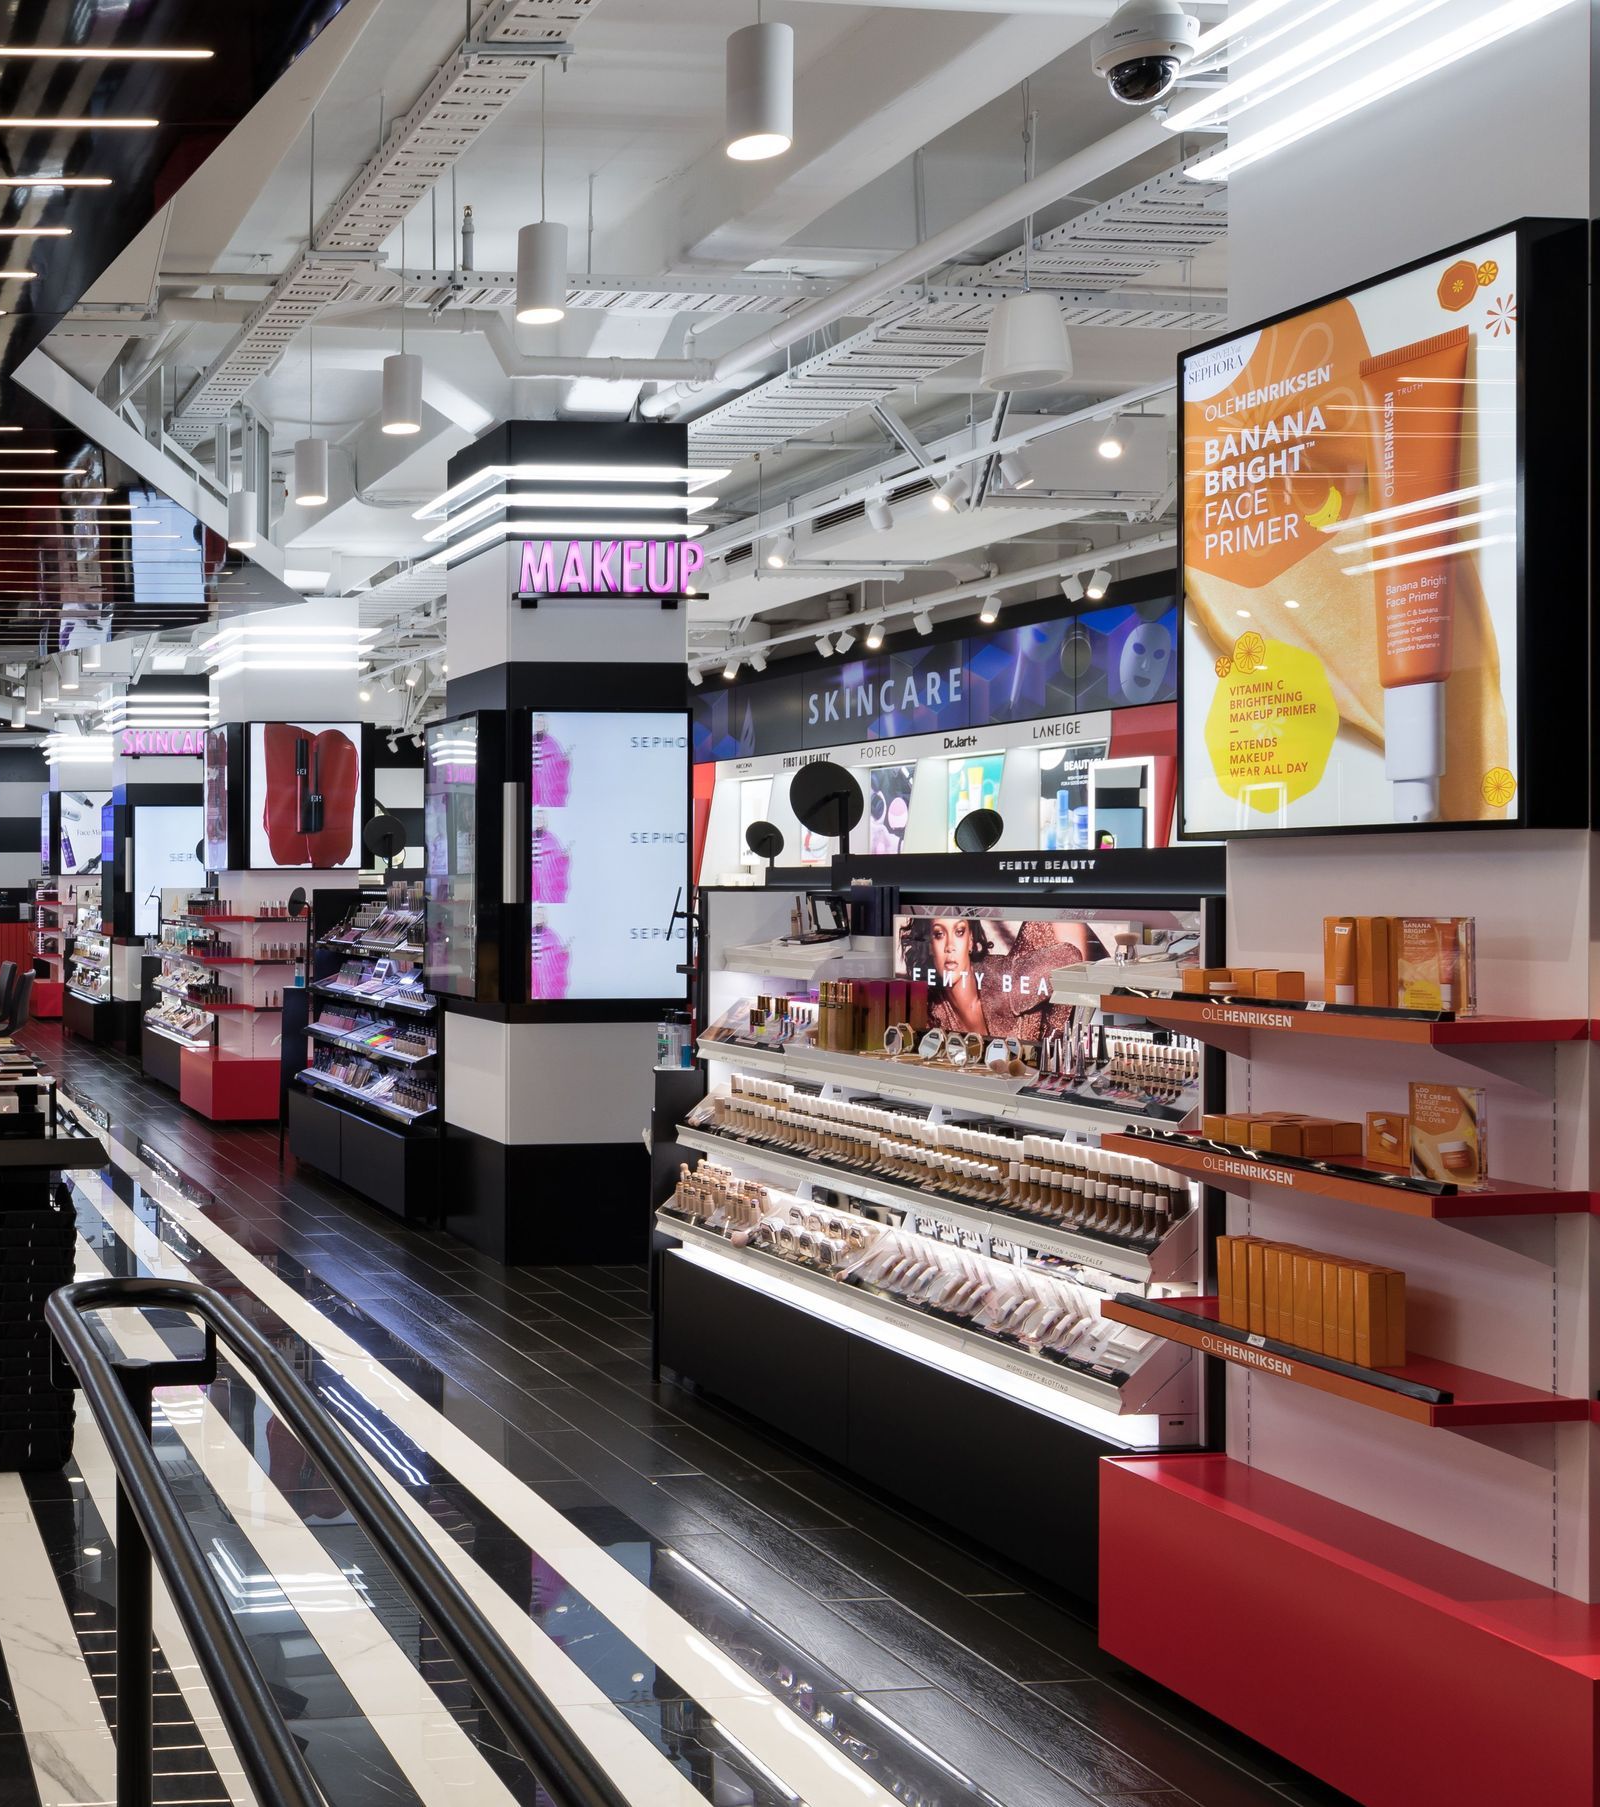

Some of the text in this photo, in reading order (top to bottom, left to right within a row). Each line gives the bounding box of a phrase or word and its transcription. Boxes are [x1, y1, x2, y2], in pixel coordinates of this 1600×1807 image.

[1187, 354, 1244, 386] SEPHORA
[1397, 382, 1424, 396] TRUTH
[1204, 406, 1326, 467] BANANA
[1204, 488, 1268, 529] FACE
[1204, 513, 1300, 560] PRIMER
[519, 540, 704, 593] MAKEUP
[1386, 575, 1447, 595] Banana Bright
[1386, 591, 1439, 608] Face Primer
[808, 667, 963, 726] SKINCARE
[1229, 680, 1284, 696] VITAMIN C
[1229, 691, 1303, 710] BRIGHTENING
[1229, 704, 1316, 723] MAKEUP PRIMER
[1032, 720, 1081, 740] LANEIGE
[860, 744, 896, 760] FOREO
[943, 735, 977, 749] Dr.Jart+
[1229, 737, 1278, 752] EXTENDS
[783, 756, 798, 768] FIRST
[1229, 751, 1274, 765] MAKEUP
[1229, 762, 1308, 778] WEAR ALL DAY
[999, 860, 1096, 871] FENTY BEAUTY
[1201, 1007, 1294, 1029] OLEHENRIKSEN
[1202, 1155, 1295, 1187] OLEHENRIKSEN
[1028, 1239, 1103, 1266] FOUNDATION CONCEALER
[1200, 1335, 1294, 1377] OLEHENRIKSEN
[1006, 1363, 1069, 1392] HIGHLIGHT BLOTTING
